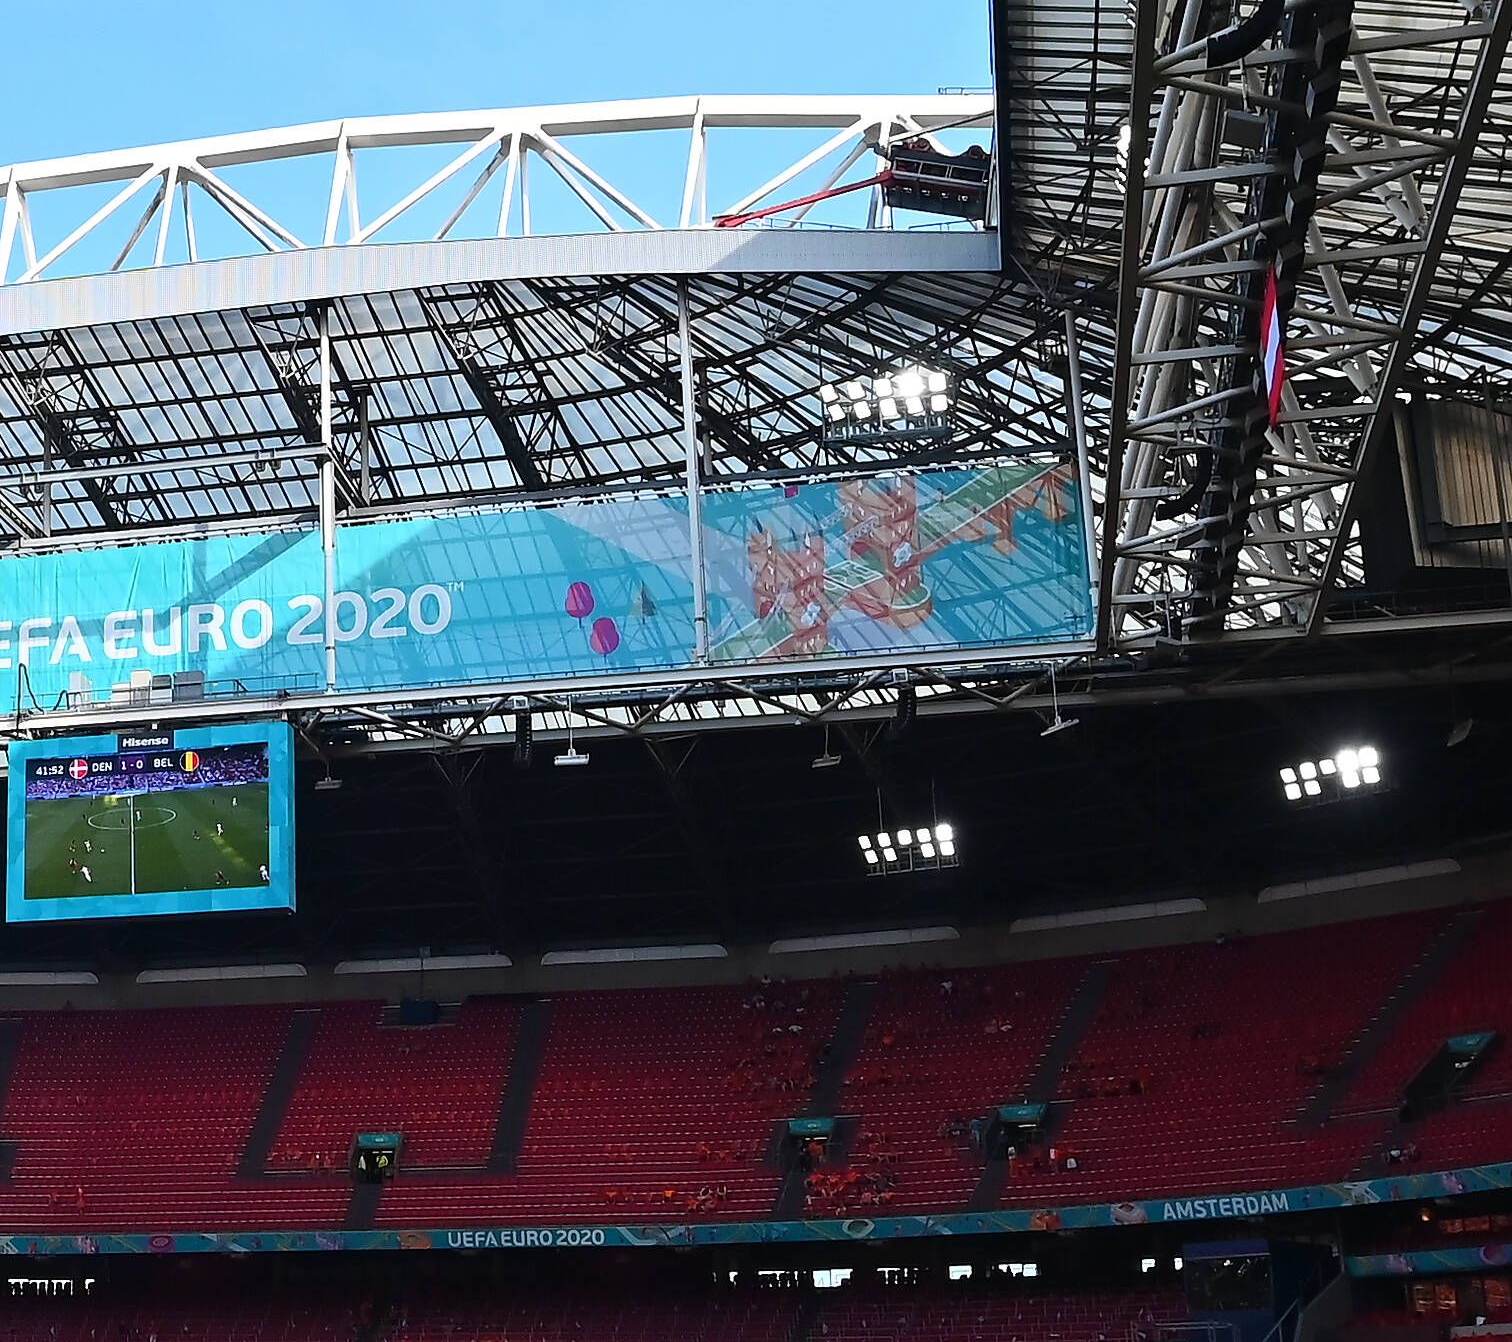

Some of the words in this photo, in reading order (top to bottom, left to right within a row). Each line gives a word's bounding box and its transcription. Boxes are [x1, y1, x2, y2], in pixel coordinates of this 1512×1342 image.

[103, 599, 274, 660] EURO
[122, 737, 169, 748] Hisense
[35, 765, 64, 776] 41:52
[92, 761, 113, 772] DEN
[153, 758, 174, 768] BEL
[1163, 1193, 1289, 1220] AMSTERDAM
[448, 1231, 498, 1247] UEFA
[500, 1230, 553, 1247] EURO
[555, 1229, 605, 1246] 2020
